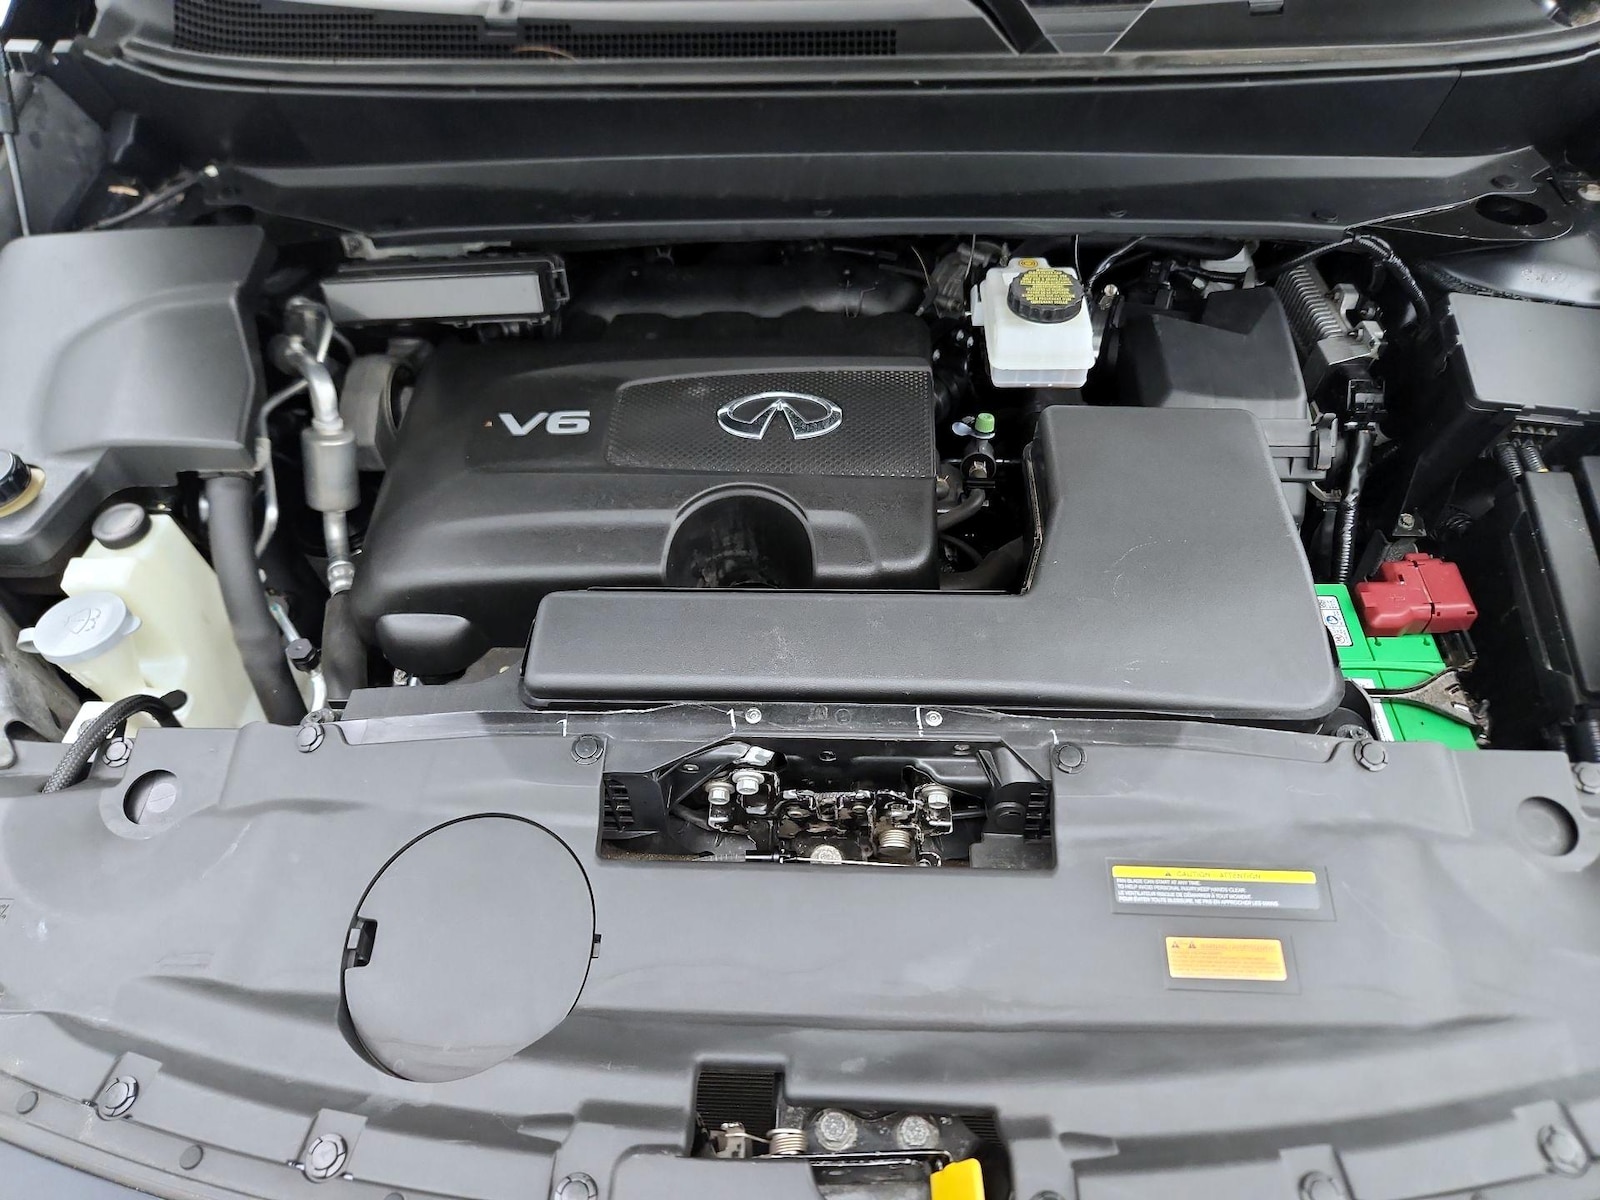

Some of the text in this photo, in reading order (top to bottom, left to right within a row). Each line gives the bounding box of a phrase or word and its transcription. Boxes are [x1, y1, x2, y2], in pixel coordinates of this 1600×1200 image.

[498, 410, 591, 437] V6
[1176, 870, 1262, 880] CAUTION ATTENTION
